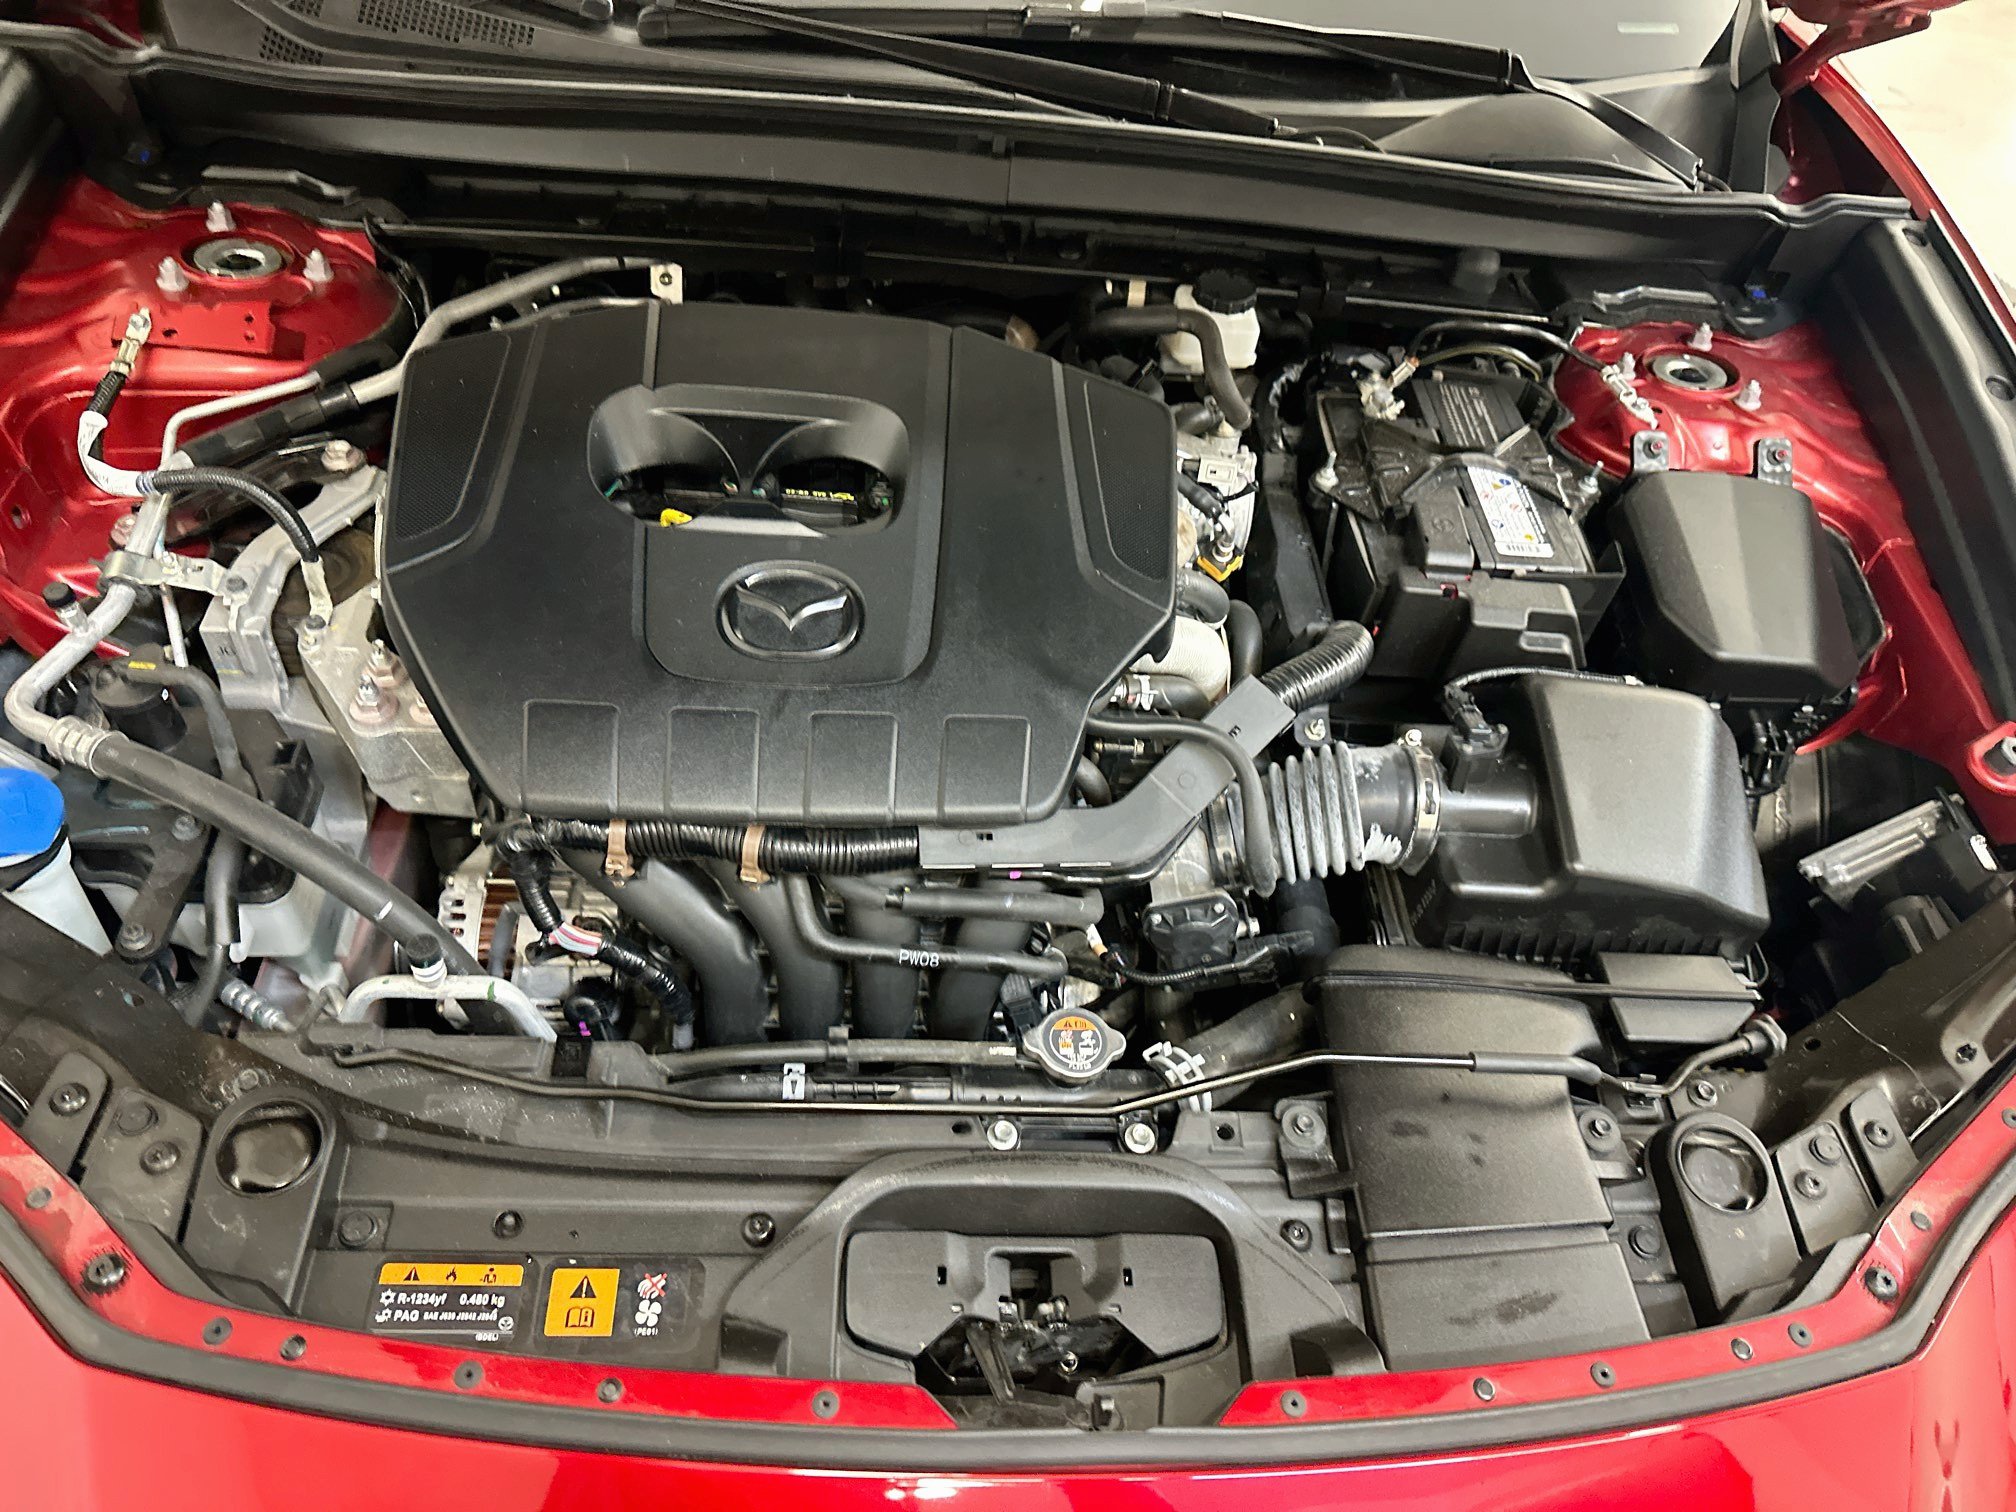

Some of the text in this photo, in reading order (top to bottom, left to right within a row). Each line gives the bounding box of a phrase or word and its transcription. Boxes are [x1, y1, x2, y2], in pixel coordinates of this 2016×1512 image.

[899, 948, 939, 968] PW08
[397, 1292, 447, 1307] R-1234yf
[491, 1293, 505, 1308] kg
